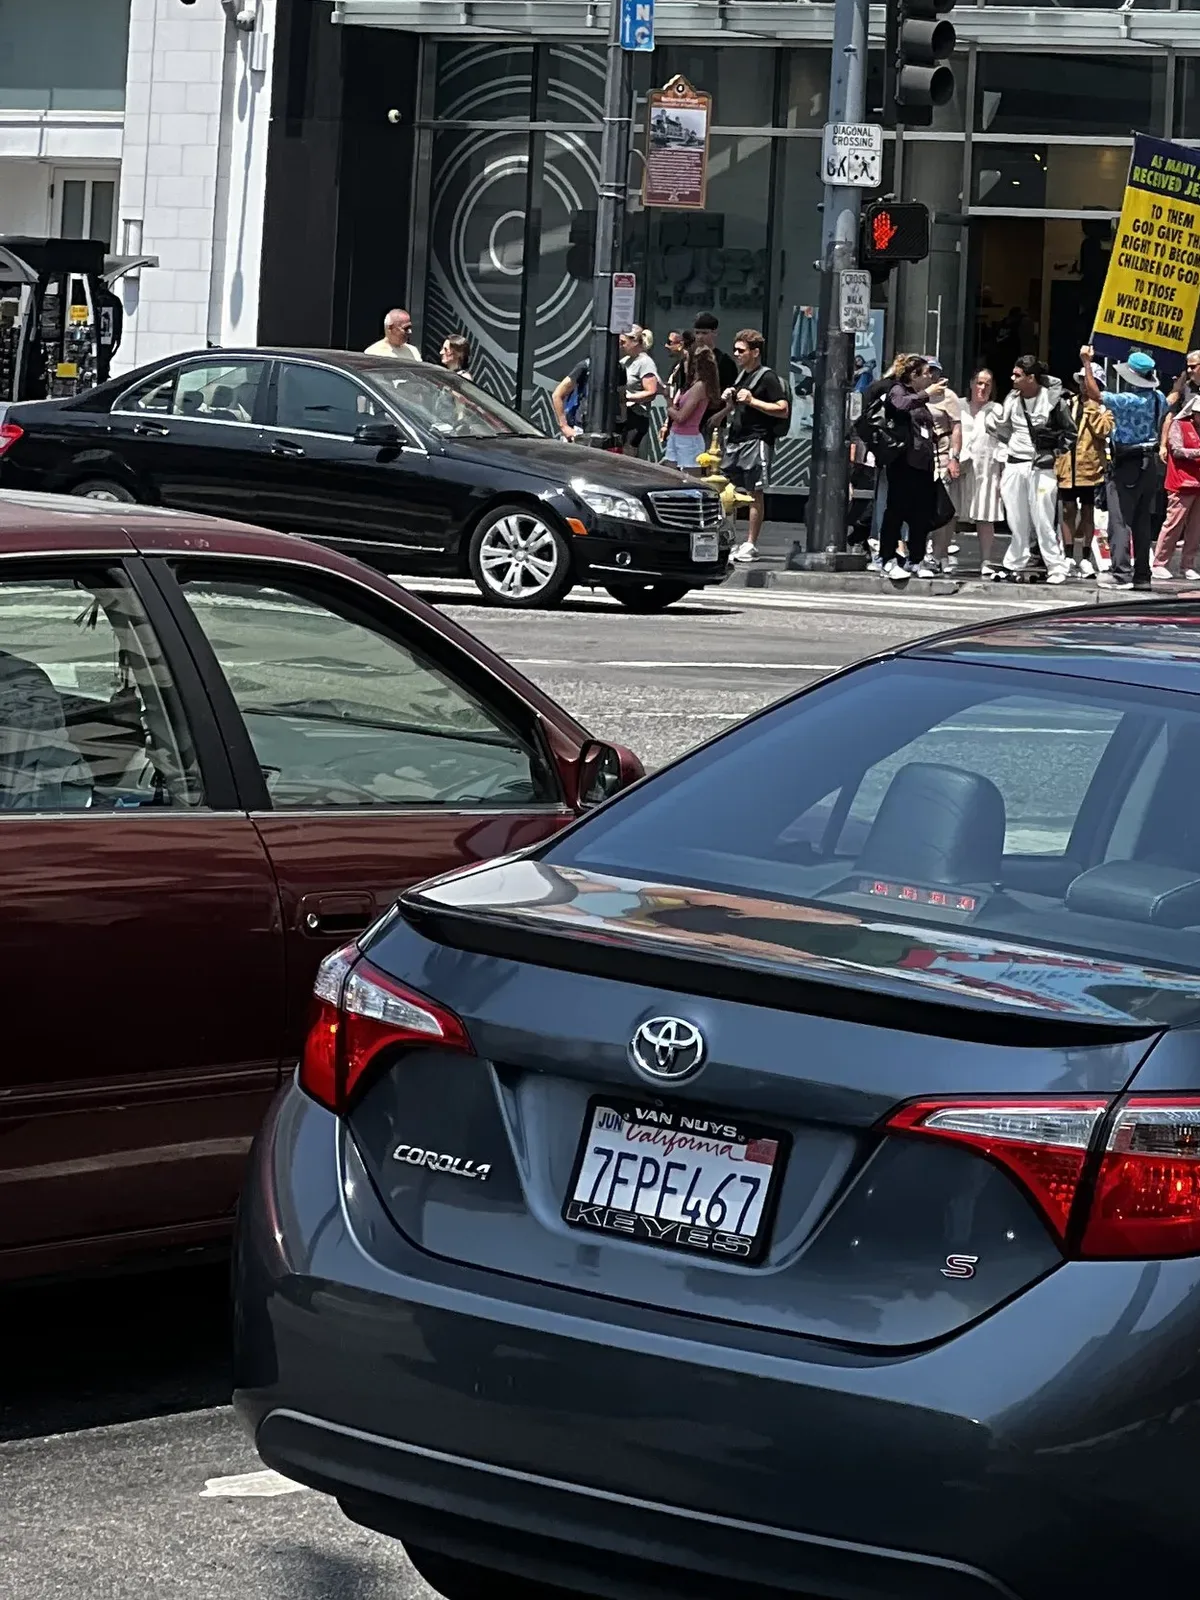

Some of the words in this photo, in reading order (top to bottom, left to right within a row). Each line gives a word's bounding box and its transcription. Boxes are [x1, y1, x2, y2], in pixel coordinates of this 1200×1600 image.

[832, 136, 874, 148] CROSSING
[833, 124, 874, 137] DIAGONAL
[1151, 154, 1164, 168] AS
[1165, 158, 1197, 178] MANY
[1133, 166, 1183, 192] RECEIVED
[1151, 204, 1163, 219] TO
[1167, 209, 1195, 229] THEM
[1132, 219, 1154, 236] GOD
[1157, 225, 1184, 244] GAVE
[1121, 235, 1151, 257] RIGHT
[1153, 242, 1166, 258] TO
[1118, 252, 1161, 276] CHILDREN
[1162, 263, 1176, 279] OF
[1177, 268, 1200, 289] GOD,
[1134, 278, 1144, 294] TO
[1147, 281, 1177, 301] THOSE
[1103, 309, 1116, 324] IN
[1116, 292, 1140, 311] WHO
[1140, 300, 1184, 322] BELIEVED
[598, 1111, 623, 1132] JUN
[634, 1108, 673, 1125] VAN
[679, 1116, 738, 1138] NUYS
[625, 1122, 744, 1162] California
[392, 1144, 492, 1180] COROLLA
[565, 1201, 753, 1257] KEYES
[941, 1252, 980, 1279] S
